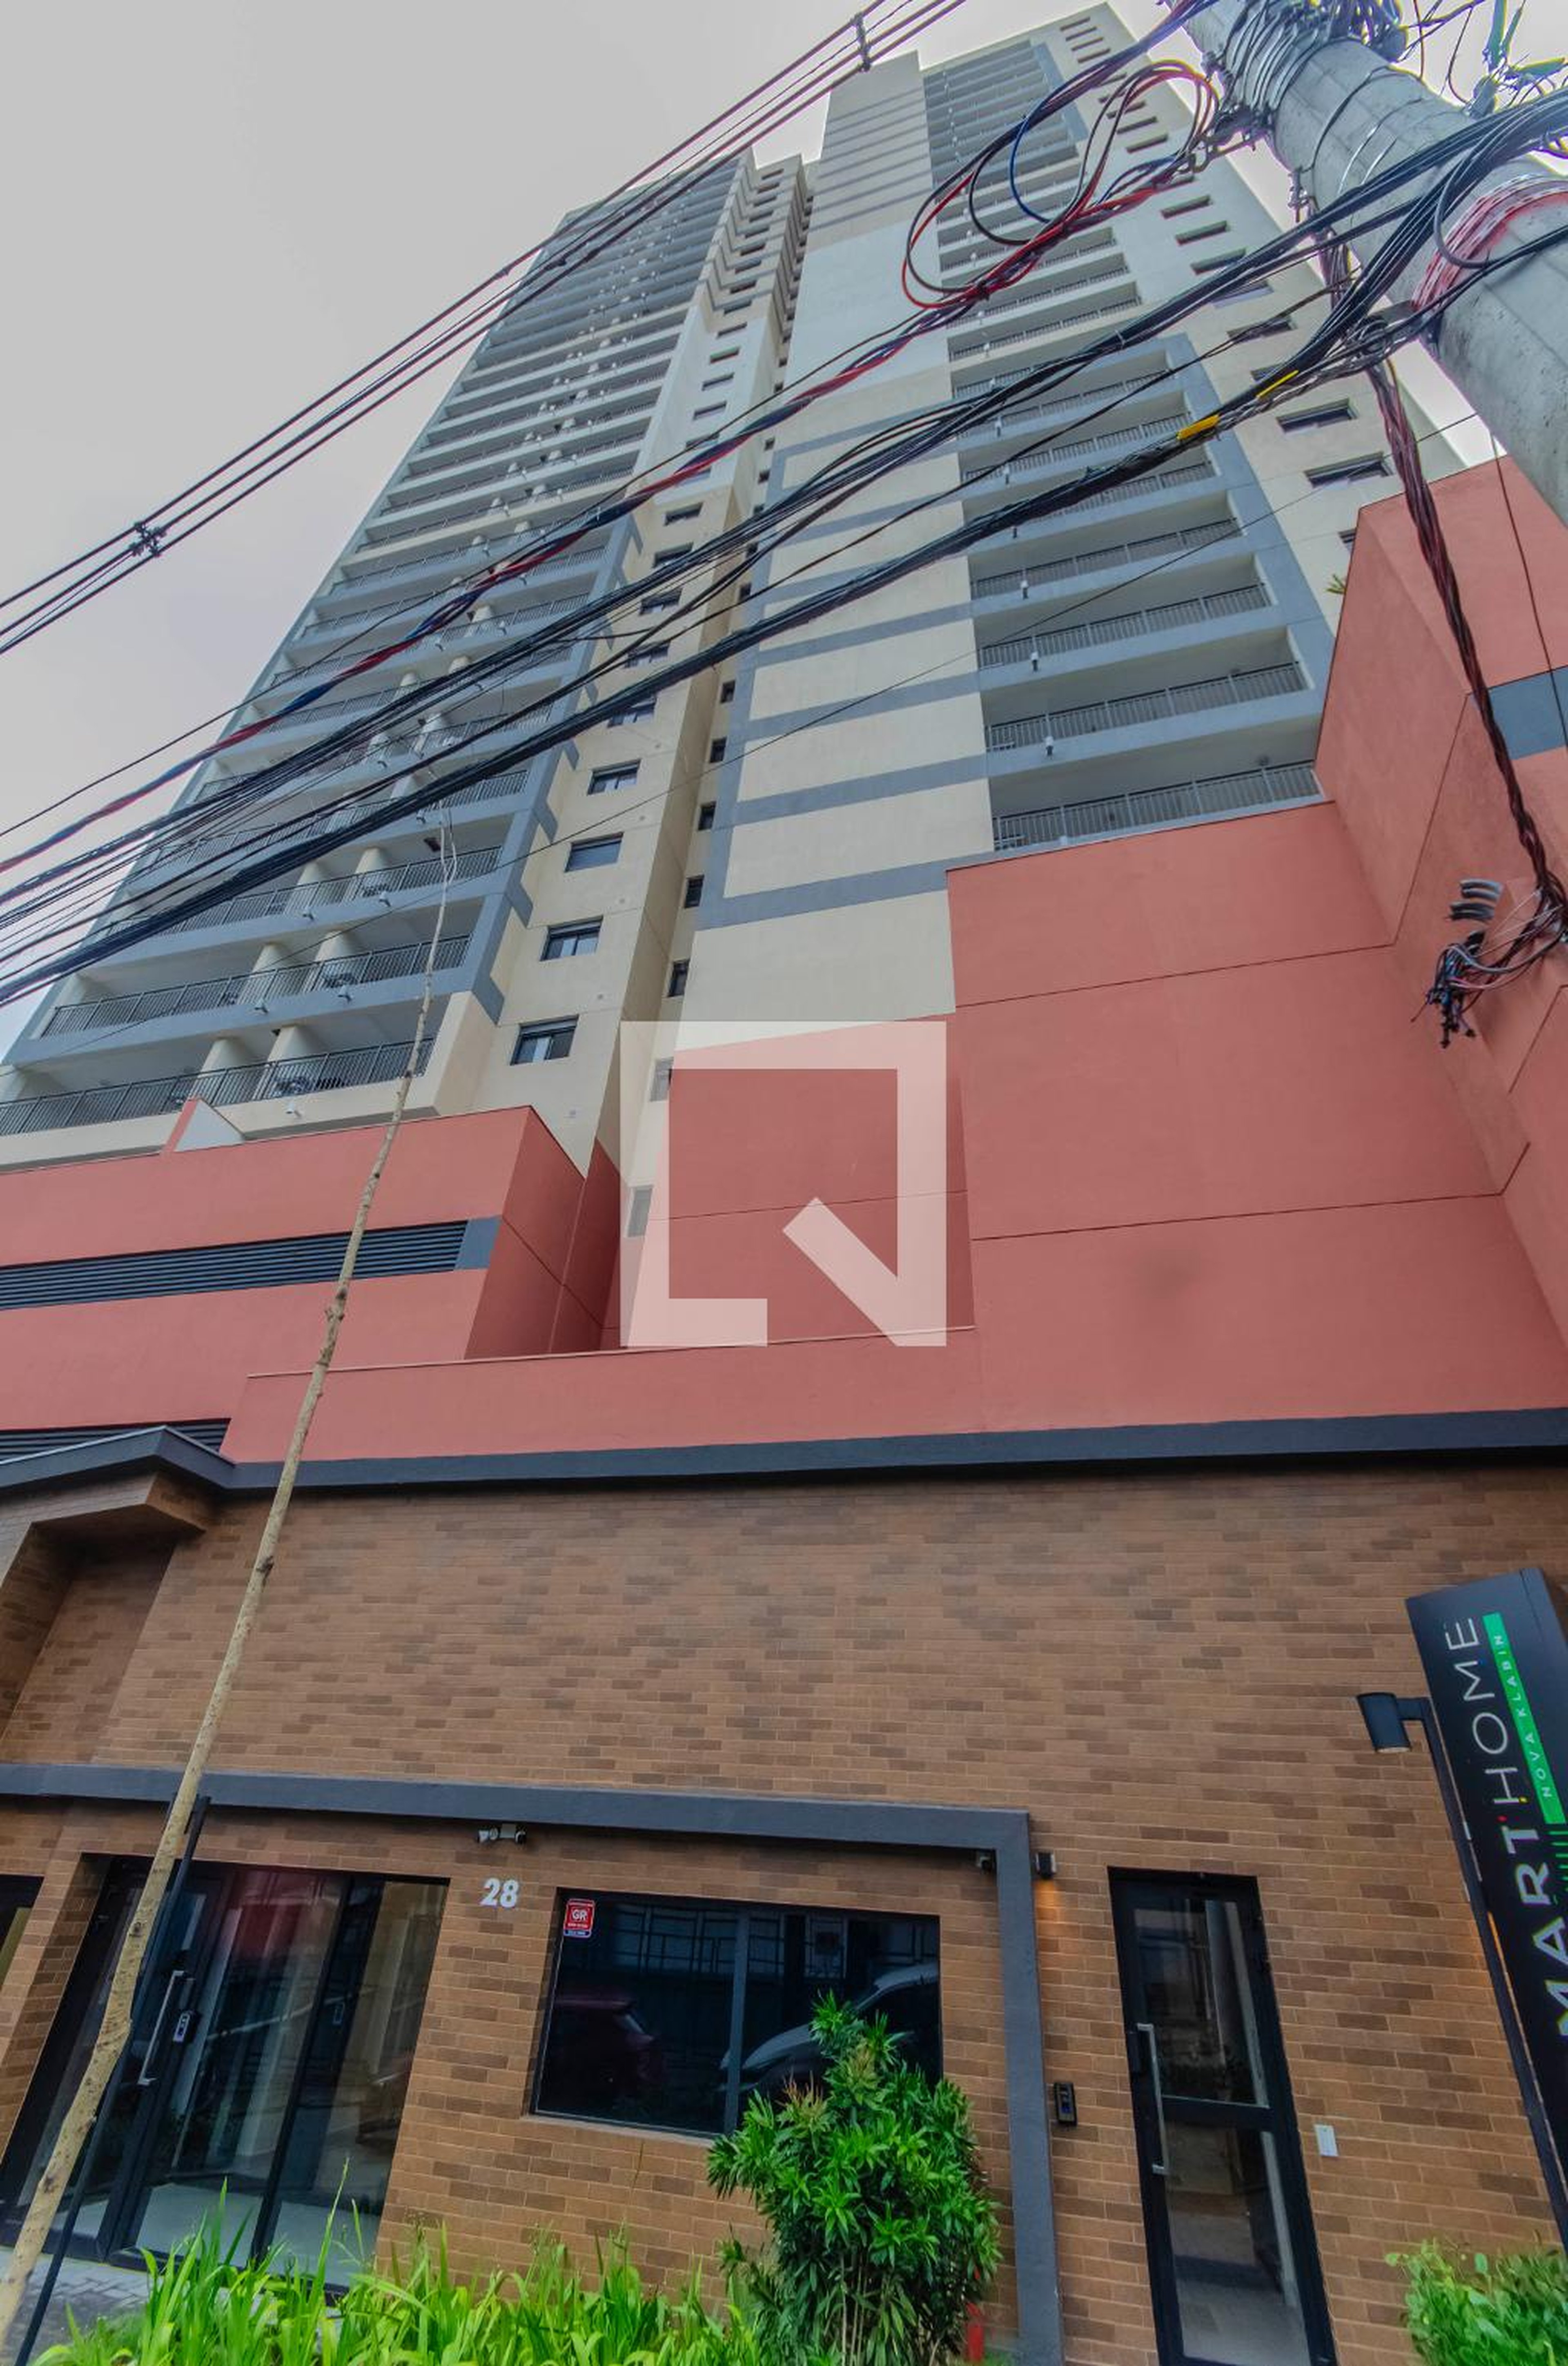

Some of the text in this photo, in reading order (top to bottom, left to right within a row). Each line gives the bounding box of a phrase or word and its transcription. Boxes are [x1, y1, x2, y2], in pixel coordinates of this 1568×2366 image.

[1445, 1618, 1526, 1804] HOME
[1494, 1635, 1552, 1798] NOVA KLABIN
[480, 1878, 519, 1908] 28
[572, 1909, 587, 1920] GR
